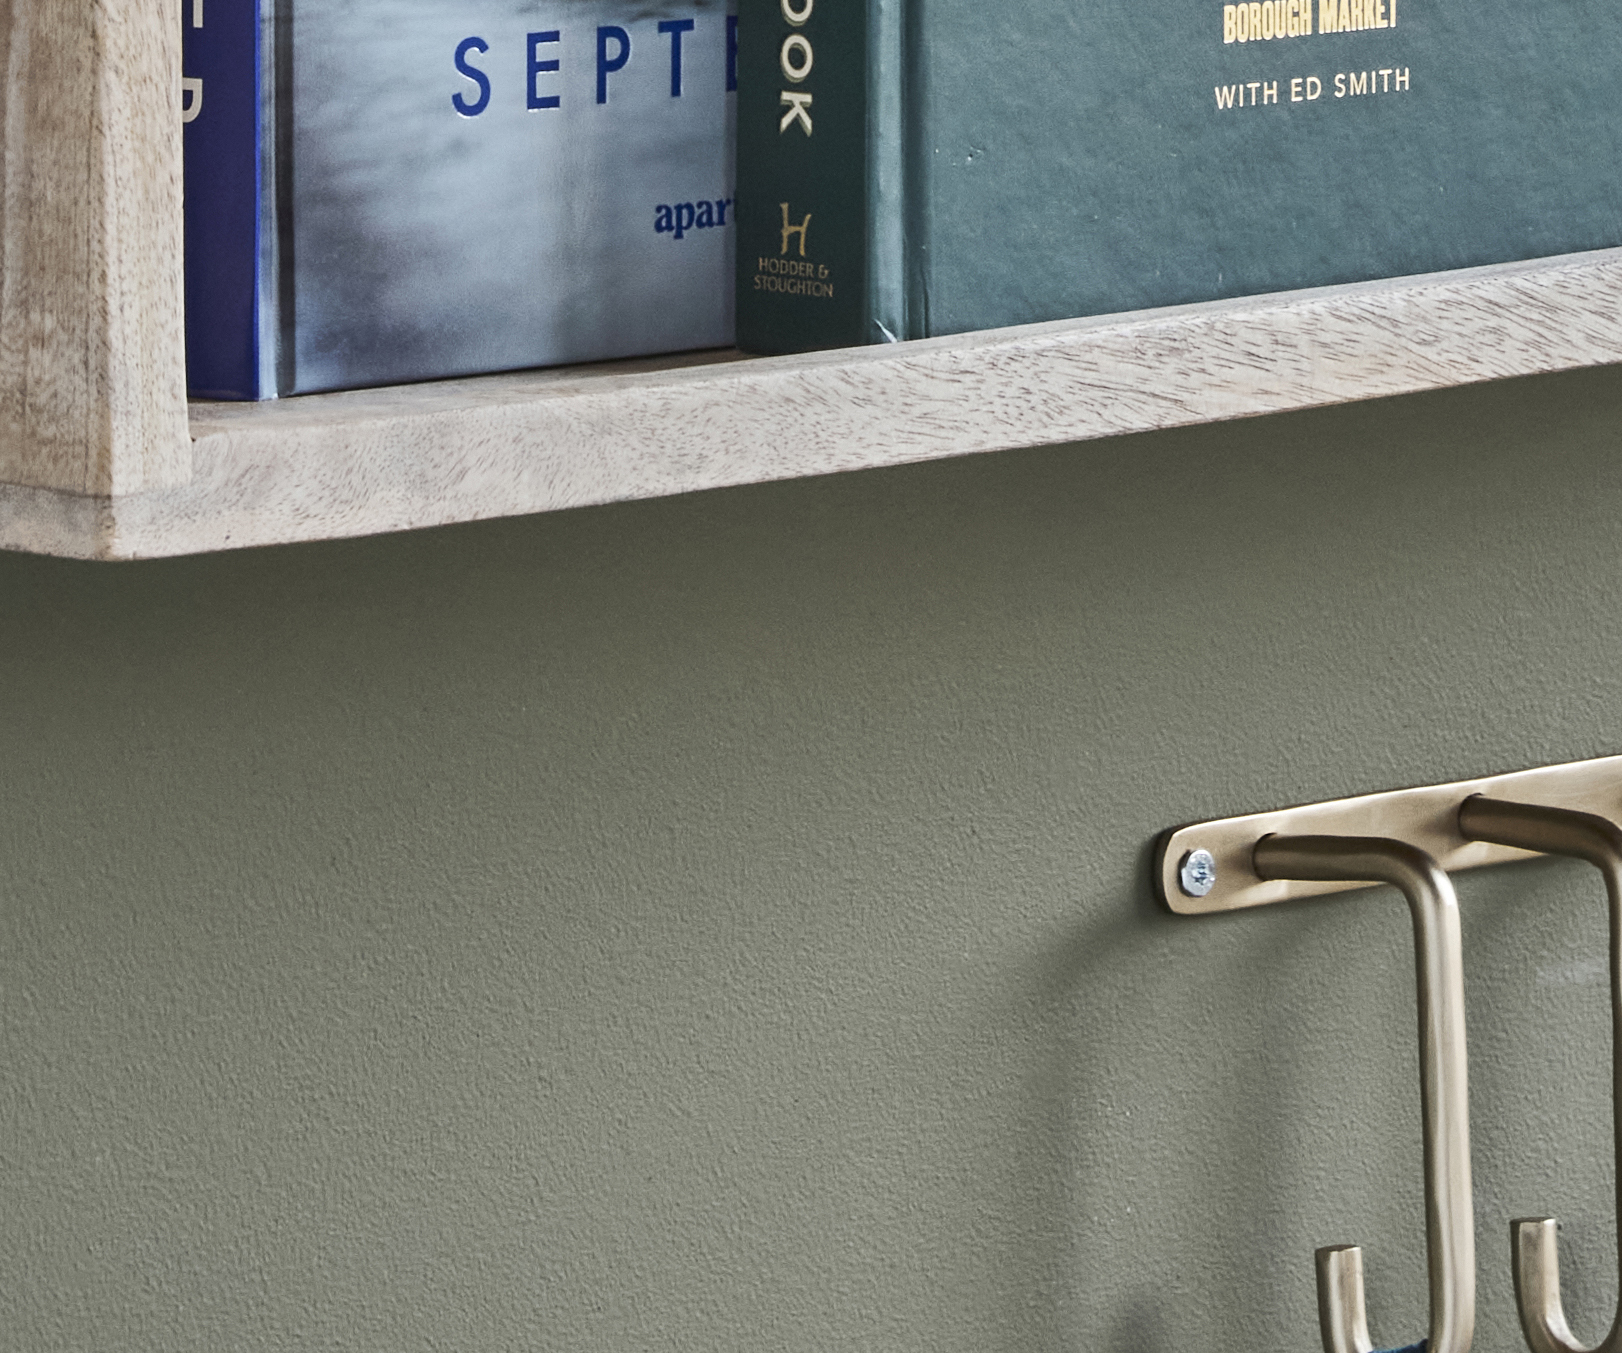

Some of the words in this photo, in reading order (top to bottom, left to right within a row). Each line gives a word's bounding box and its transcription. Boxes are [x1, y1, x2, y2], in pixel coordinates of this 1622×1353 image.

[1214, 80, 1278, 110] WITH
[1290, 76, 1322, 103] ED
[1334, 66, 1410, 98] SMITH
[758, 256, 815, 279] HODDER
[818, 263, 829, 279] &
[754, 274, 833, 298] STOUGHTON
